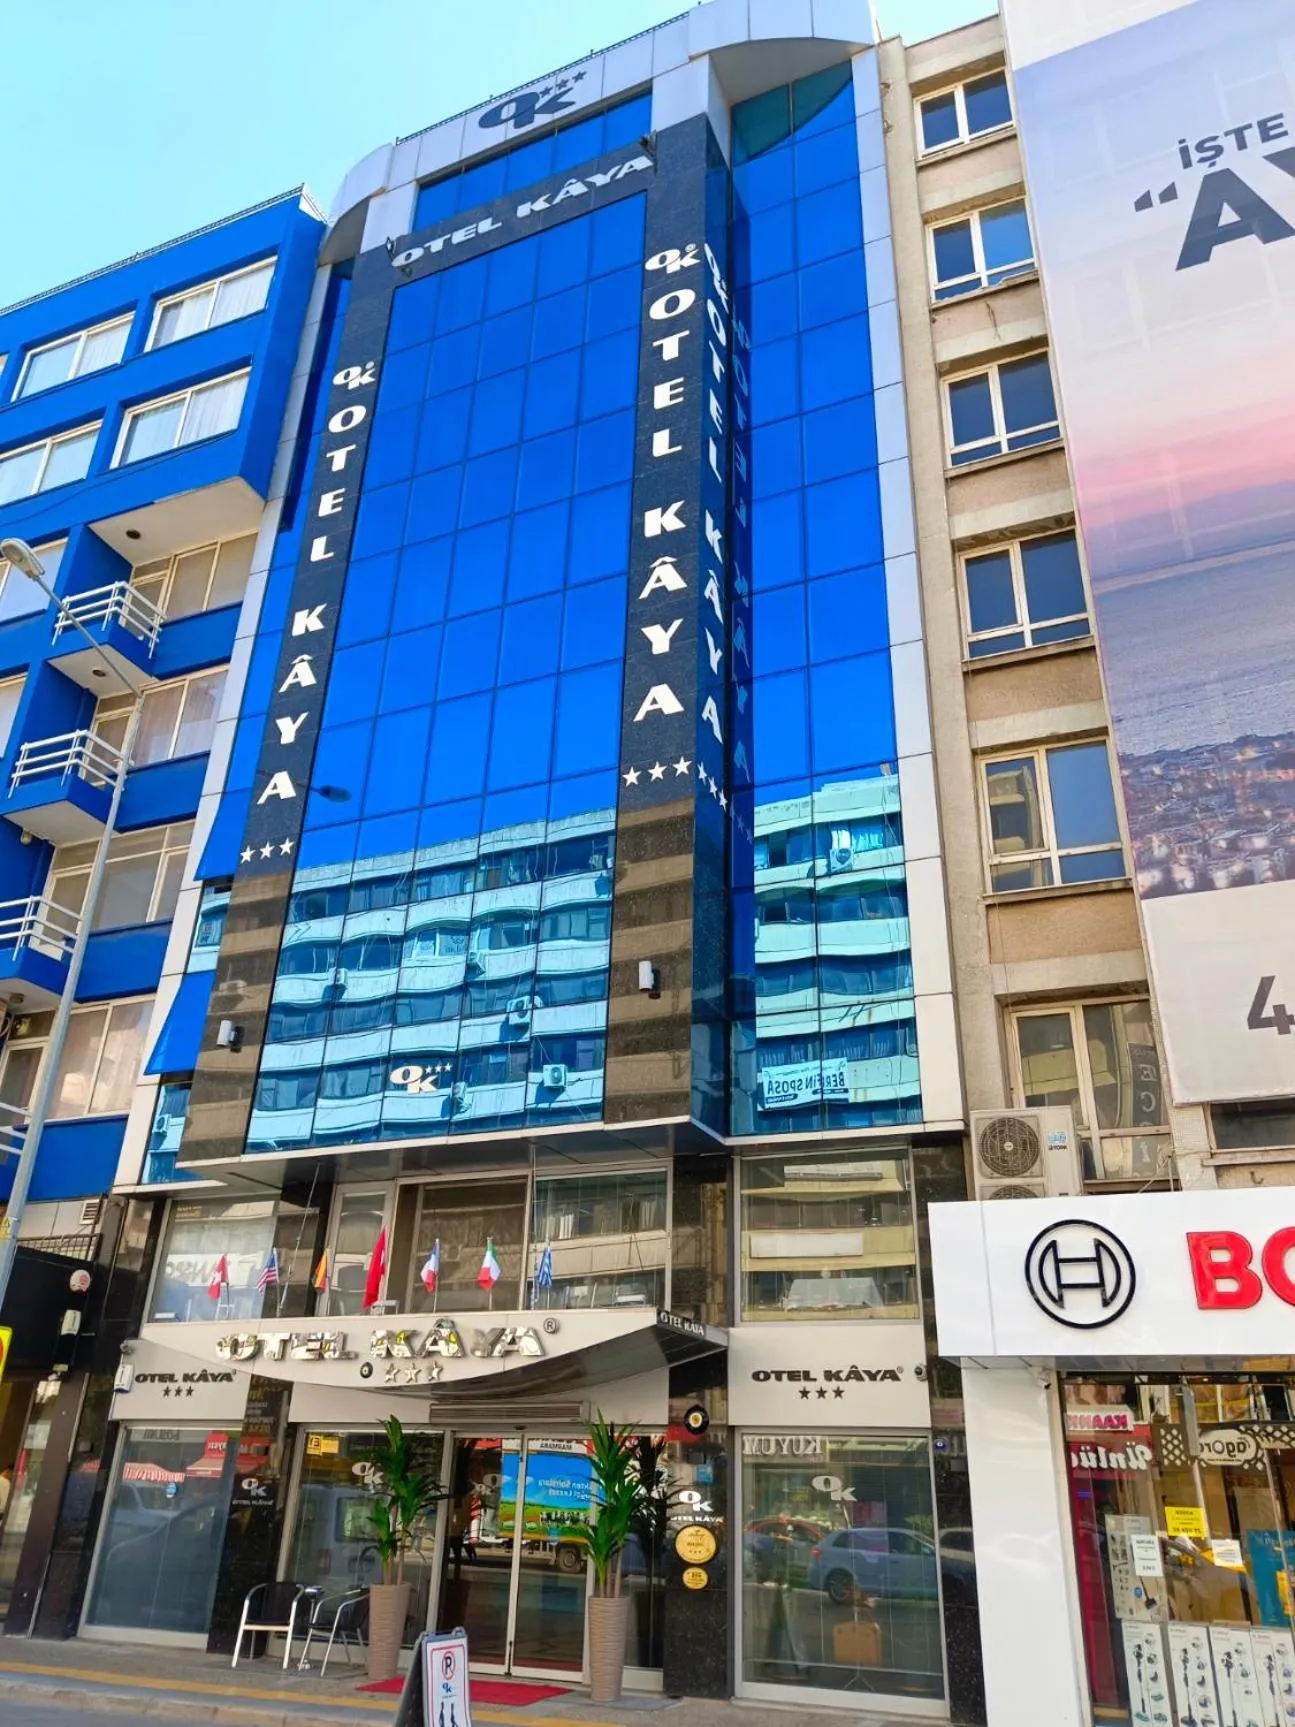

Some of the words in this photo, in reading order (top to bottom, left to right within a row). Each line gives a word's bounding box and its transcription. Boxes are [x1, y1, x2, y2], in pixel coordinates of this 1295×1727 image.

[1177, 112, 1289, 170] İŞTE
[391, 216, 503, 269] OTEL
[516, 155, 653, 219] KÂYA
[649, 288, 696, 458] OTEL
[310, 404, 367, 563] OTEL
[633, 500, 688, 723] KÂYA
[256, 603, 327, 806] KÂYA
[135, 1373, 178, 1383] OTEL
[182, 1368, 233, 1383] KÂYA
[216, 1330, 358, 1361] OTEL
[370, 1318, 547, 1359] KÂYA
[751, 1369, 817, 1382] OTEL
[823, 1364, 902, 1382] KÂYA
